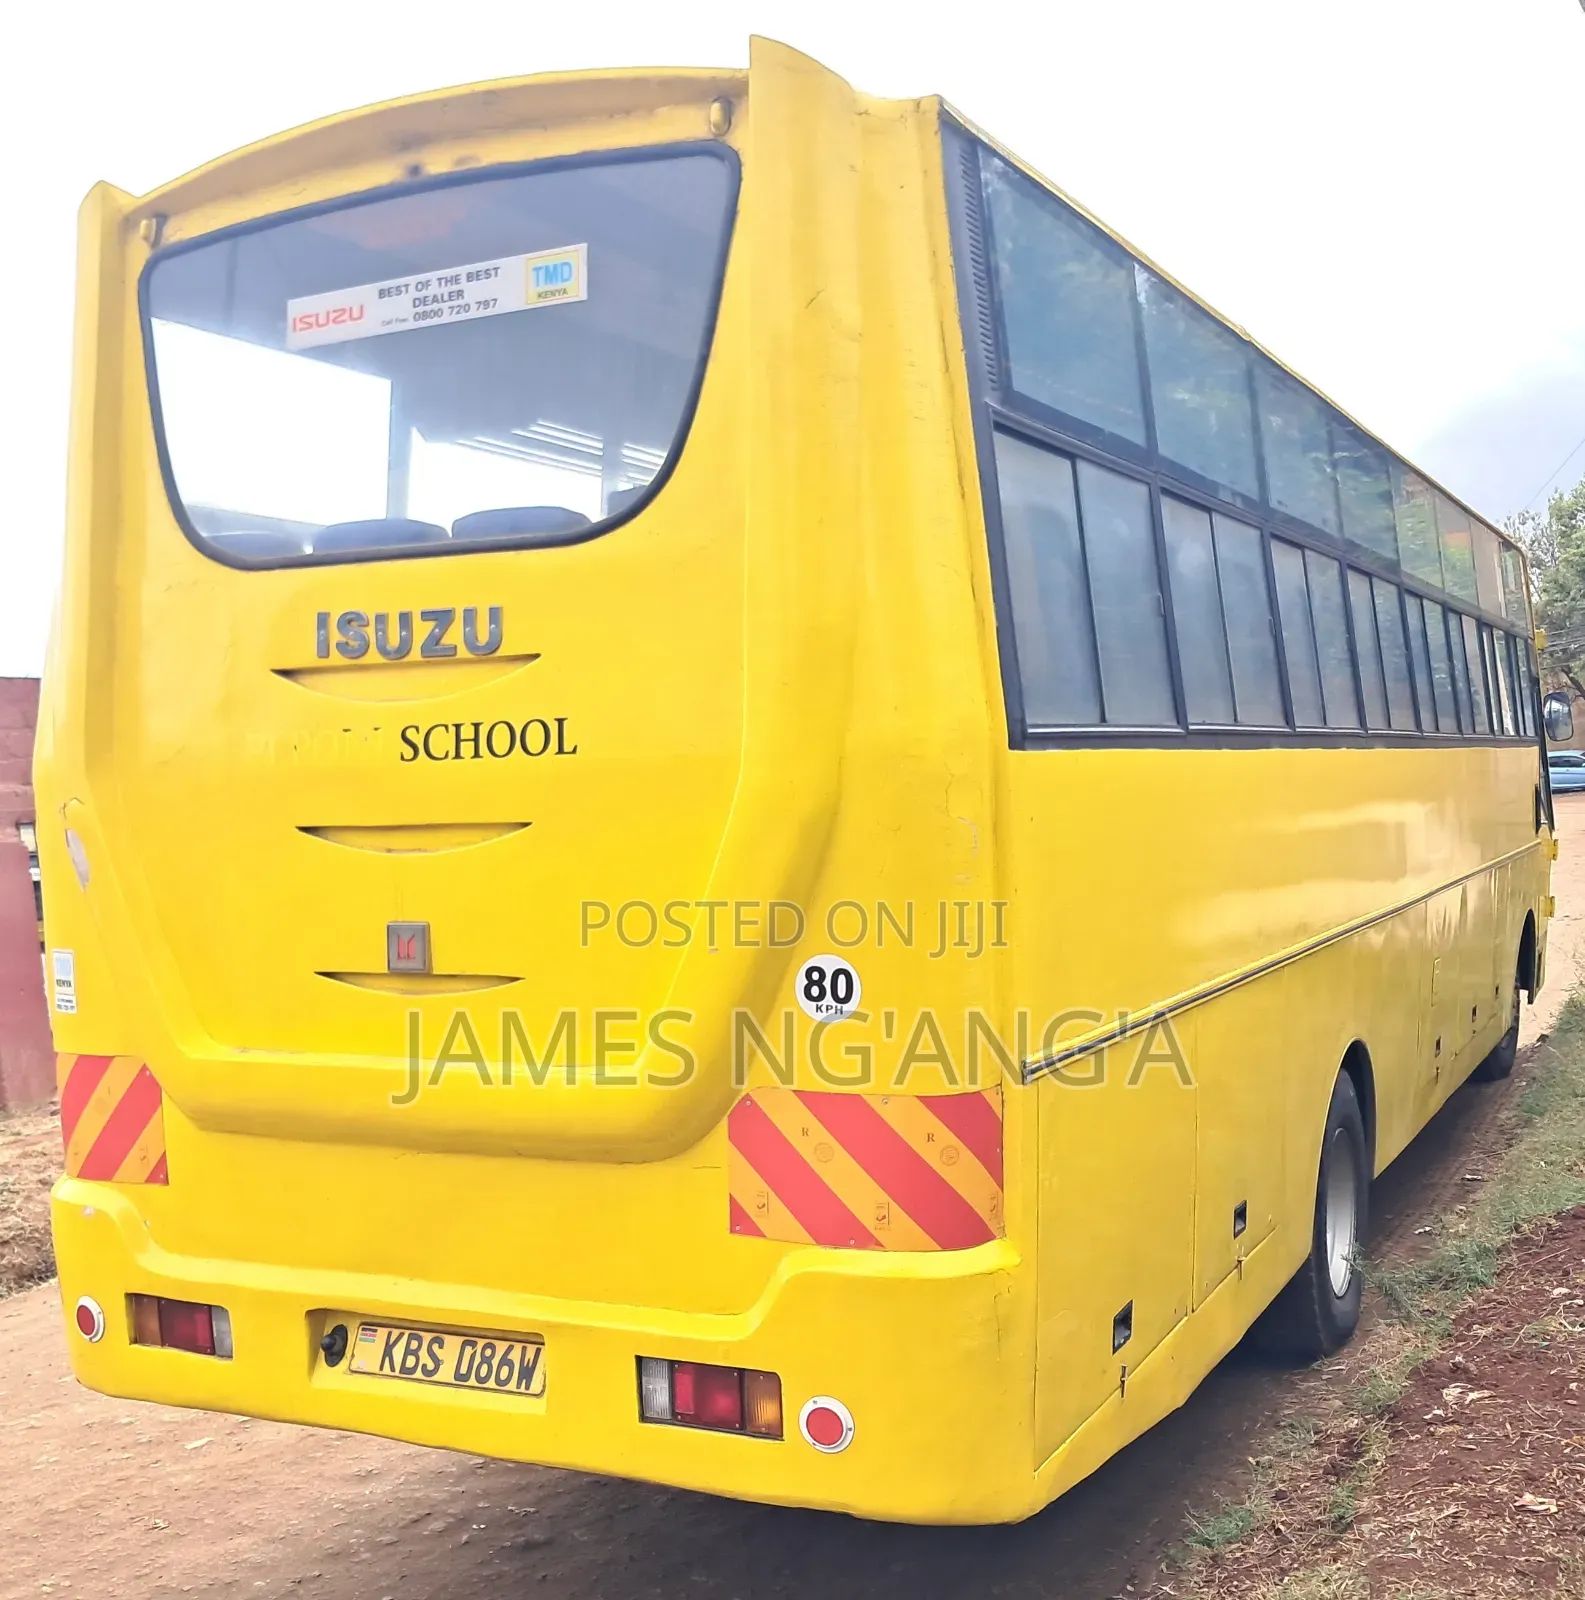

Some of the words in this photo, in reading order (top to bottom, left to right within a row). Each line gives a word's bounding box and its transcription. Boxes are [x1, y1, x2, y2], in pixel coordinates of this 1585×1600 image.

[378, 284, 411, 300] BEST
[414, 279, 433, 293] OF
[437, 274, 462, 289] THE
[466, 266, 501, 284] BEST
[532, 261, 572, 288] TMD
[412, 289, 465, 309] DEALER
[537, 287, 569, 300] KENYA
[293, 304, 364, 333] ISUZU
[412, 307, 444, 323] 0800
[448, 302, 471, 316] 720
[475, 297, 499, 312] 797
[316, 605, 503, 661] ISUZU
[400, 717, 578, 762] SCHOOL
[803, 965, 854, 1005] 80
[815, 1003, 844, 1016] KPH
[379, 1330, 445, 1378] KBS
[453, 1339, 542, 1391] 086W
